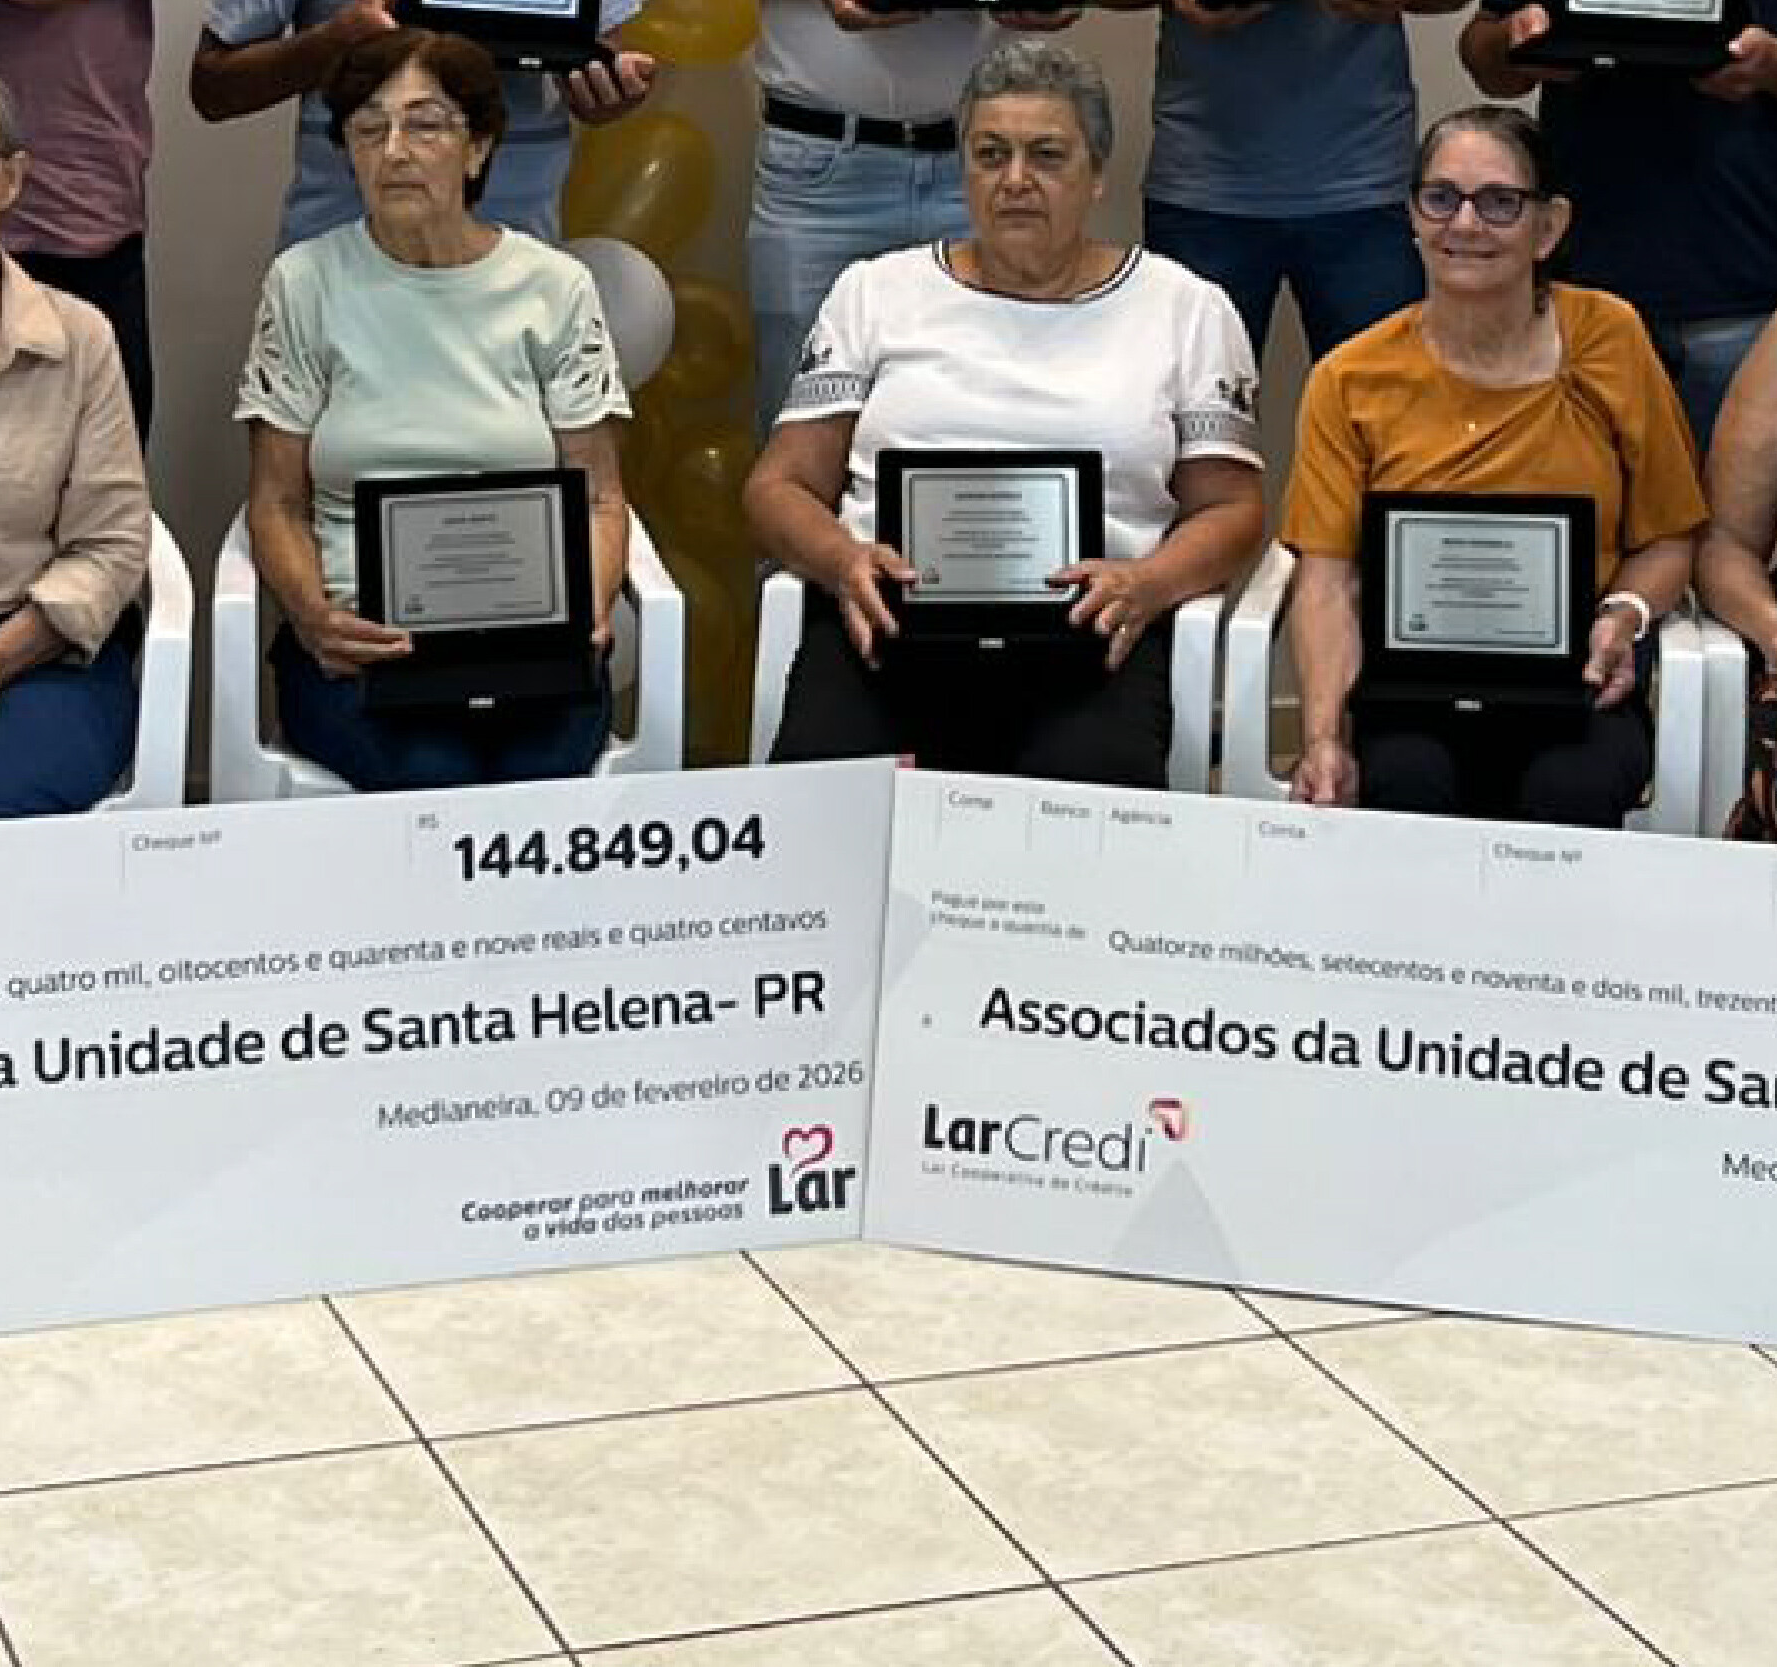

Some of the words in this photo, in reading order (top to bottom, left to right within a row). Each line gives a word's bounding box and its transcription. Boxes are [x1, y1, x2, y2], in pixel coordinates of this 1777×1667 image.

[453, 813, 765, 882] 144.849,04
[7, 969, 96, 1002] quatro
[105, 961, 153, 989] mil,
[158, 950, 300, 985] oitocentos
[304, 952, 322, 972] e
[328, 939, 445, 971] quarenta
[451, 940, 469, 958] e
[475, 933, 536, 955] nove
[541, 927, 602, 951] reais
[608, 927, 623, 945] e
[628, 917, 714, 948] quatro
[719, 908, 827, 935] centavos
[1108, 929, 1213, 960] Quatorze
[1219, 940, 1315, 972] milhões,
[1321, 953, 1446, 983] setecentos
[1450, 968, 1466, 985] e
[1472, 969, 1566, 995] noventa
[1571, 980, 1586, 996] e
[1591, 979, 1643, 1002] dois
[1648, 983, 1691, 1009] mil,
[33, 1019, 265, 1084] Unidade
[281, 1011, 350, 1061] de
[362, 1000, 516, 1055] Santa
[532, 984, 739, 1038] Helena-
[755, 970, 826, 1018] PR
[981, 987, 1276, 1061] Associados
[1292, 1017, 1362, 1068] da
[1378, 1023, 1606, 1092] Unidade
[1620, 1050, 1690, 1100] de
[376, 1094, 540, 1130] Medianeira,
[547, 1086, 584, 1113] 09
[591, 1083, 626, 1110] de
[633, 1072, 750, 1104] fevereiro
[754, 1070, 791, 1093] de
[798, 1061, 864, 1089] 2026
[924, 1103, 1154, 1173] LarCredi
[461, 1194, 573, 1222] Cooperar
[577, 1190, 634, 1215] para
[640, 1176, 749, 1204] melhorar
[524, 1224, 541, 1241] a
[544, 1216, 598, 1239] vida
[602, 1207, 645, 1232] das
[650, 1201, 744, 1230] pessoas
[767, 1162, 857, 1216] Lar
